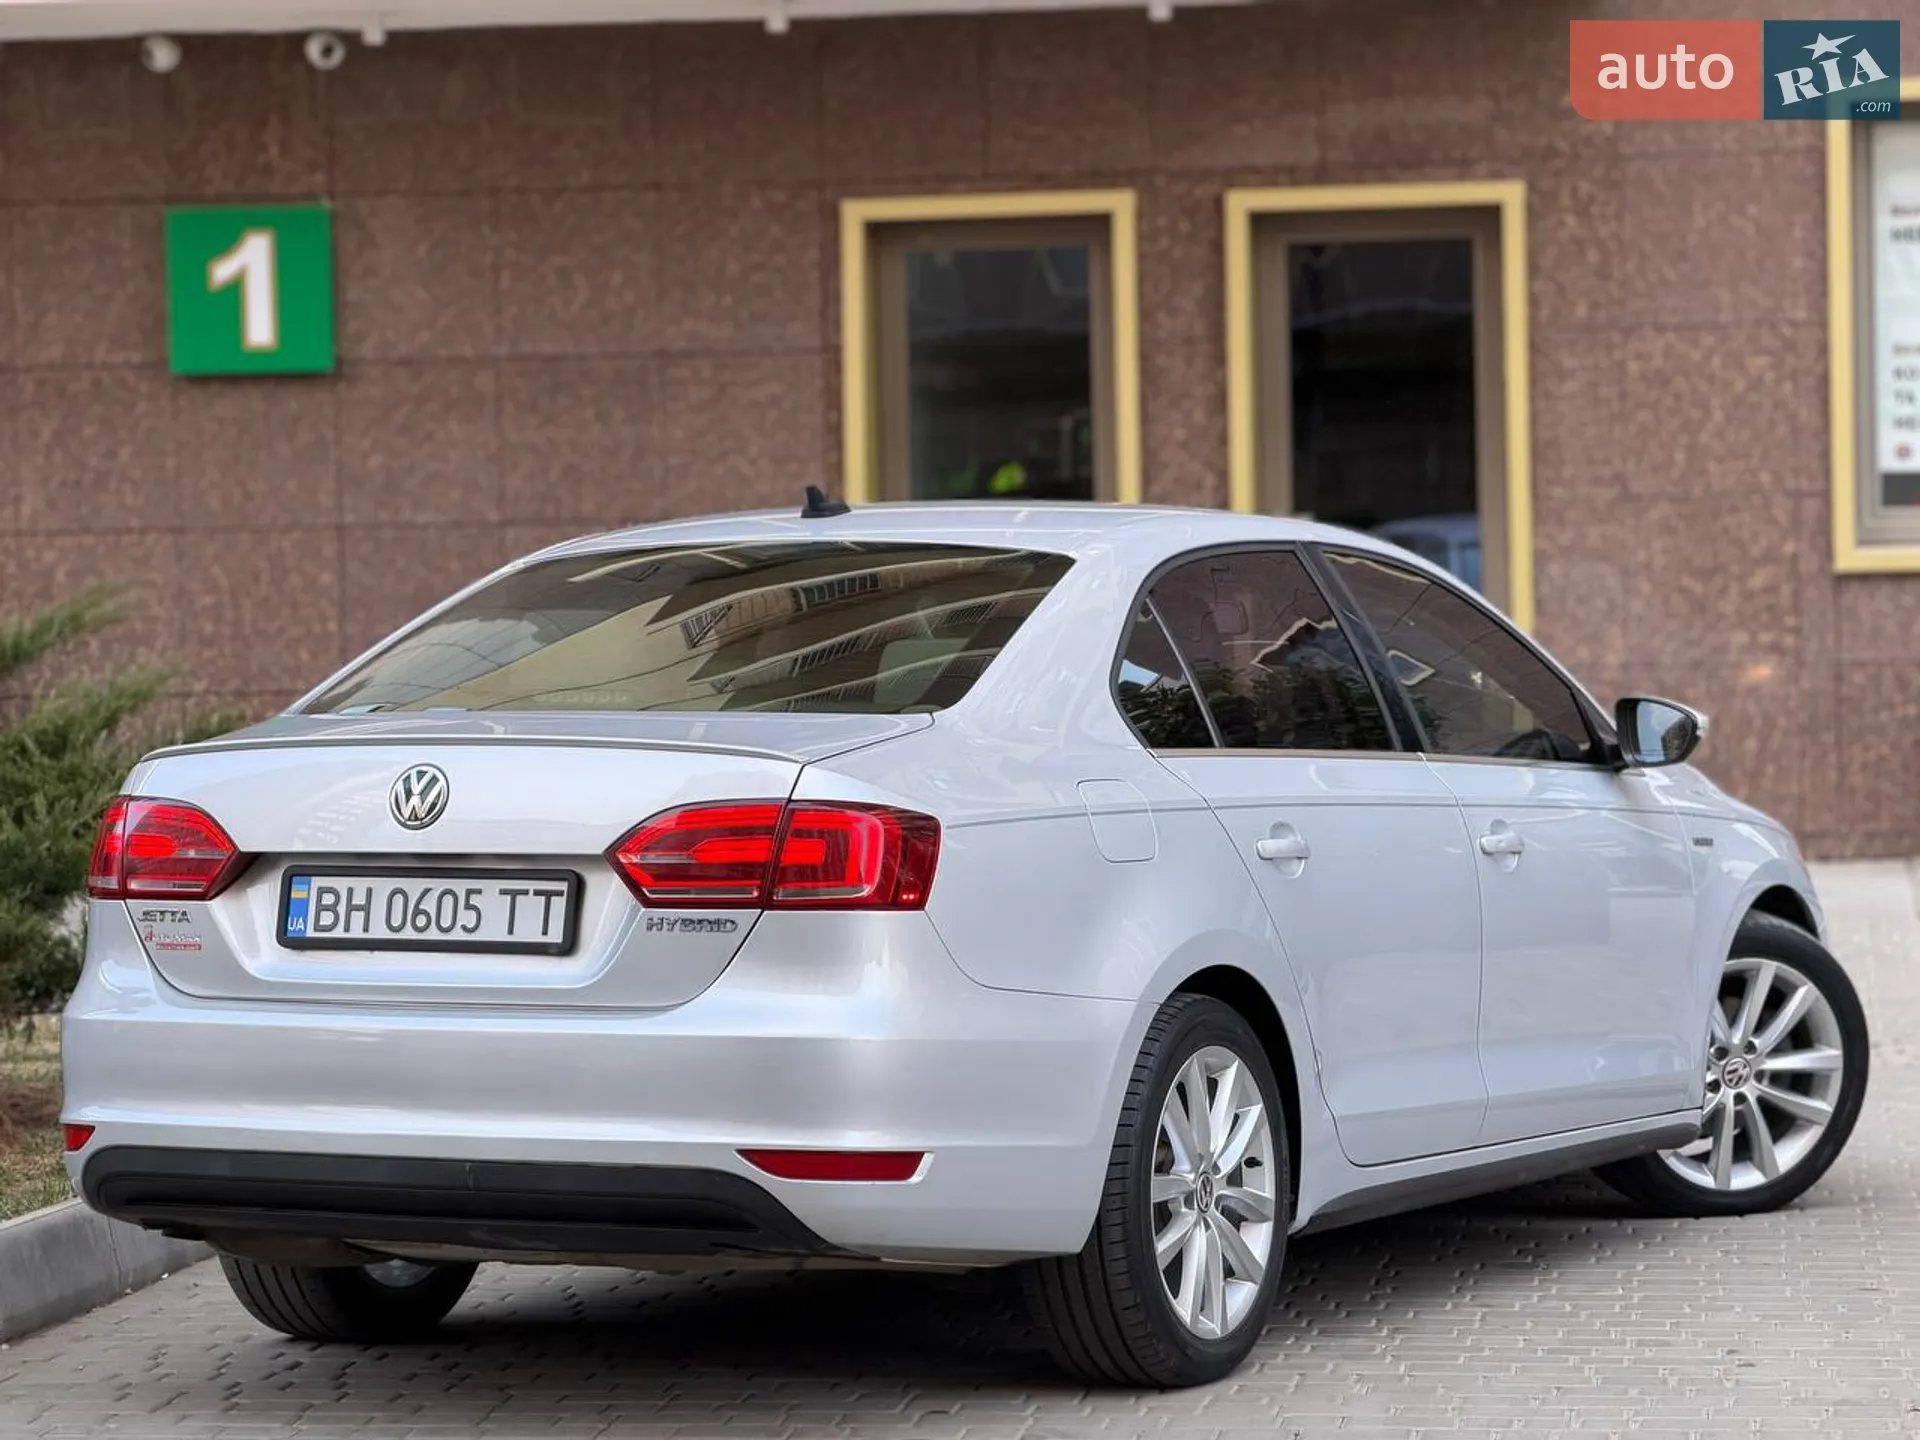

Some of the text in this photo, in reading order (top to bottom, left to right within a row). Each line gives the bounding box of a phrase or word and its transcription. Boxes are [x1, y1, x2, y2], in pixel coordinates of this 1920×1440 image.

[207, 228, 280, 353] 1
[137, 908, 191, 924] JETTA
[312, 886, 565, 936] BH 0605 TT
[287, 916, 306, 931] UA
[646, 916, 738, 933] HYBRID
